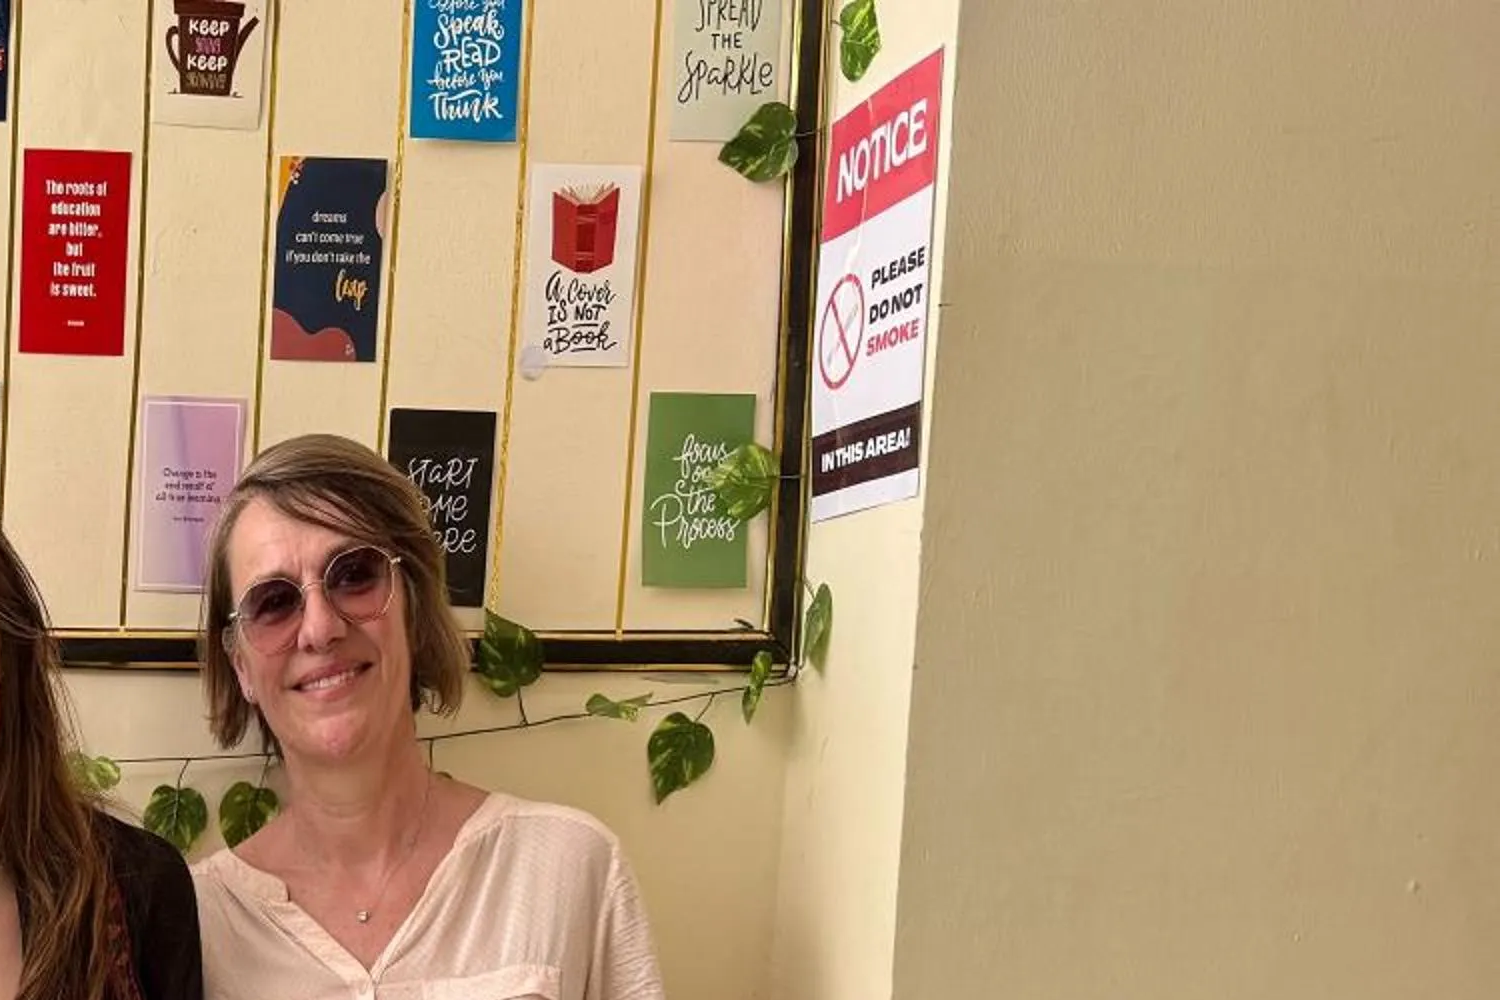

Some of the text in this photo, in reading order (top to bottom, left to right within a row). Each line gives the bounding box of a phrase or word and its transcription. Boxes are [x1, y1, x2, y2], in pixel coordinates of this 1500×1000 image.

[434, 9, 504, 48] Speak
[711, 32, 742, 50] THE
[426, 61, 477, 90] before
[428, 90, 503, 122] Think
[836, 98, 928, 204] NOTICE
[46, 179, 107, 197] The roots of
[51, 202, 100, 217] education
[311, 211, 347, 223] dreams
[48, 223, 67, 236] are
[295, 232, 318, 243] can't
[319, 233, 344, 244] come
[66, 242, 83, 257] but
[294, 252, 311, 264] you
[312, 251, 335, 263] don't
[356, 252, 371, 264] the
[53, 262, 96, 277] the fruit
[871, 246, 926, 290] PLEASE
[51, 282, 97, 297] is sweet.
[335, 268, 368, 311] leap
[546, 270, 616, 304] A Cover
[548, 300, 606, 326] IS NOT
[869, 283, 923, 324] DO NOT
[543, 320, 617, 354] a Book
[866, 318, 920, 356] SMOKE
[672, 433, 740, 479] focus
[821, 426, 911, 473] IN THIS AREA!
[675, 480, 717, 514] the
[650, 493, 740, 549] Process
